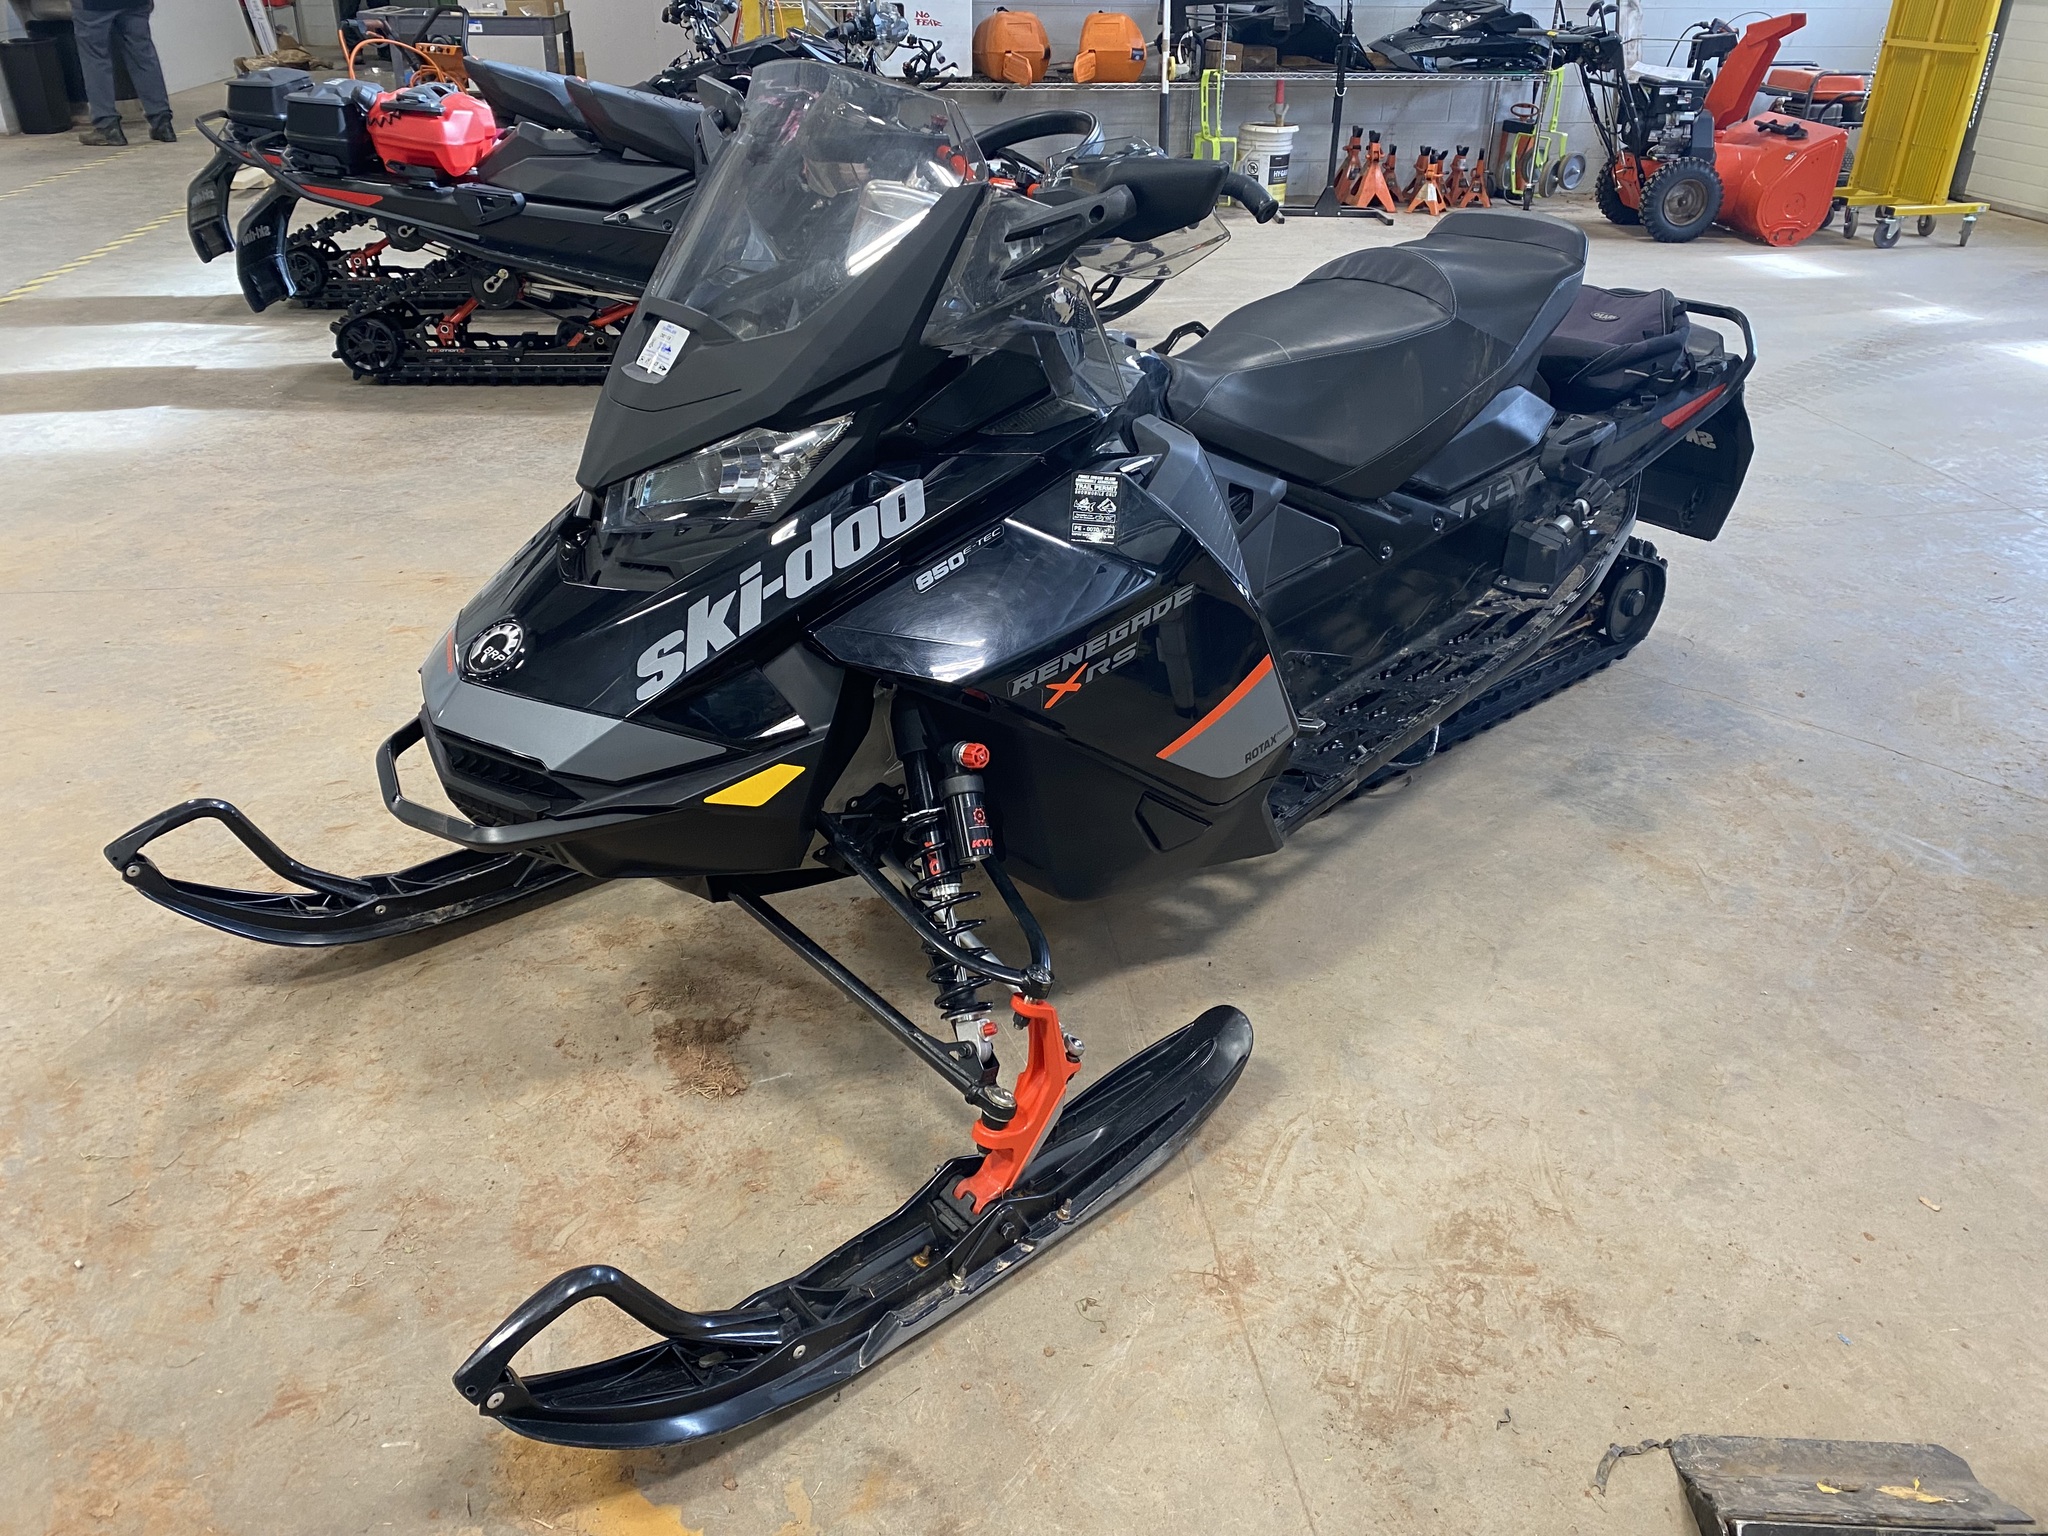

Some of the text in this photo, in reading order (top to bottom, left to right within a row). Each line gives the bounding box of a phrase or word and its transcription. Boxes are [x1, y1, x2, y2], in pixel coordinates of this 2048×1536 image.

[914, 19, 943, 27] FEAR
[915, 11, 930, 19] NO
[916, 527, 1001, 591] 850 E-TEC
[636, 479, 925, 701] ski-doo
[483, 645, 506, 661] BRP
[1011, 583, 1195, 697] RENEGADE
[1244, 733, 1277, 764] ROTAX
